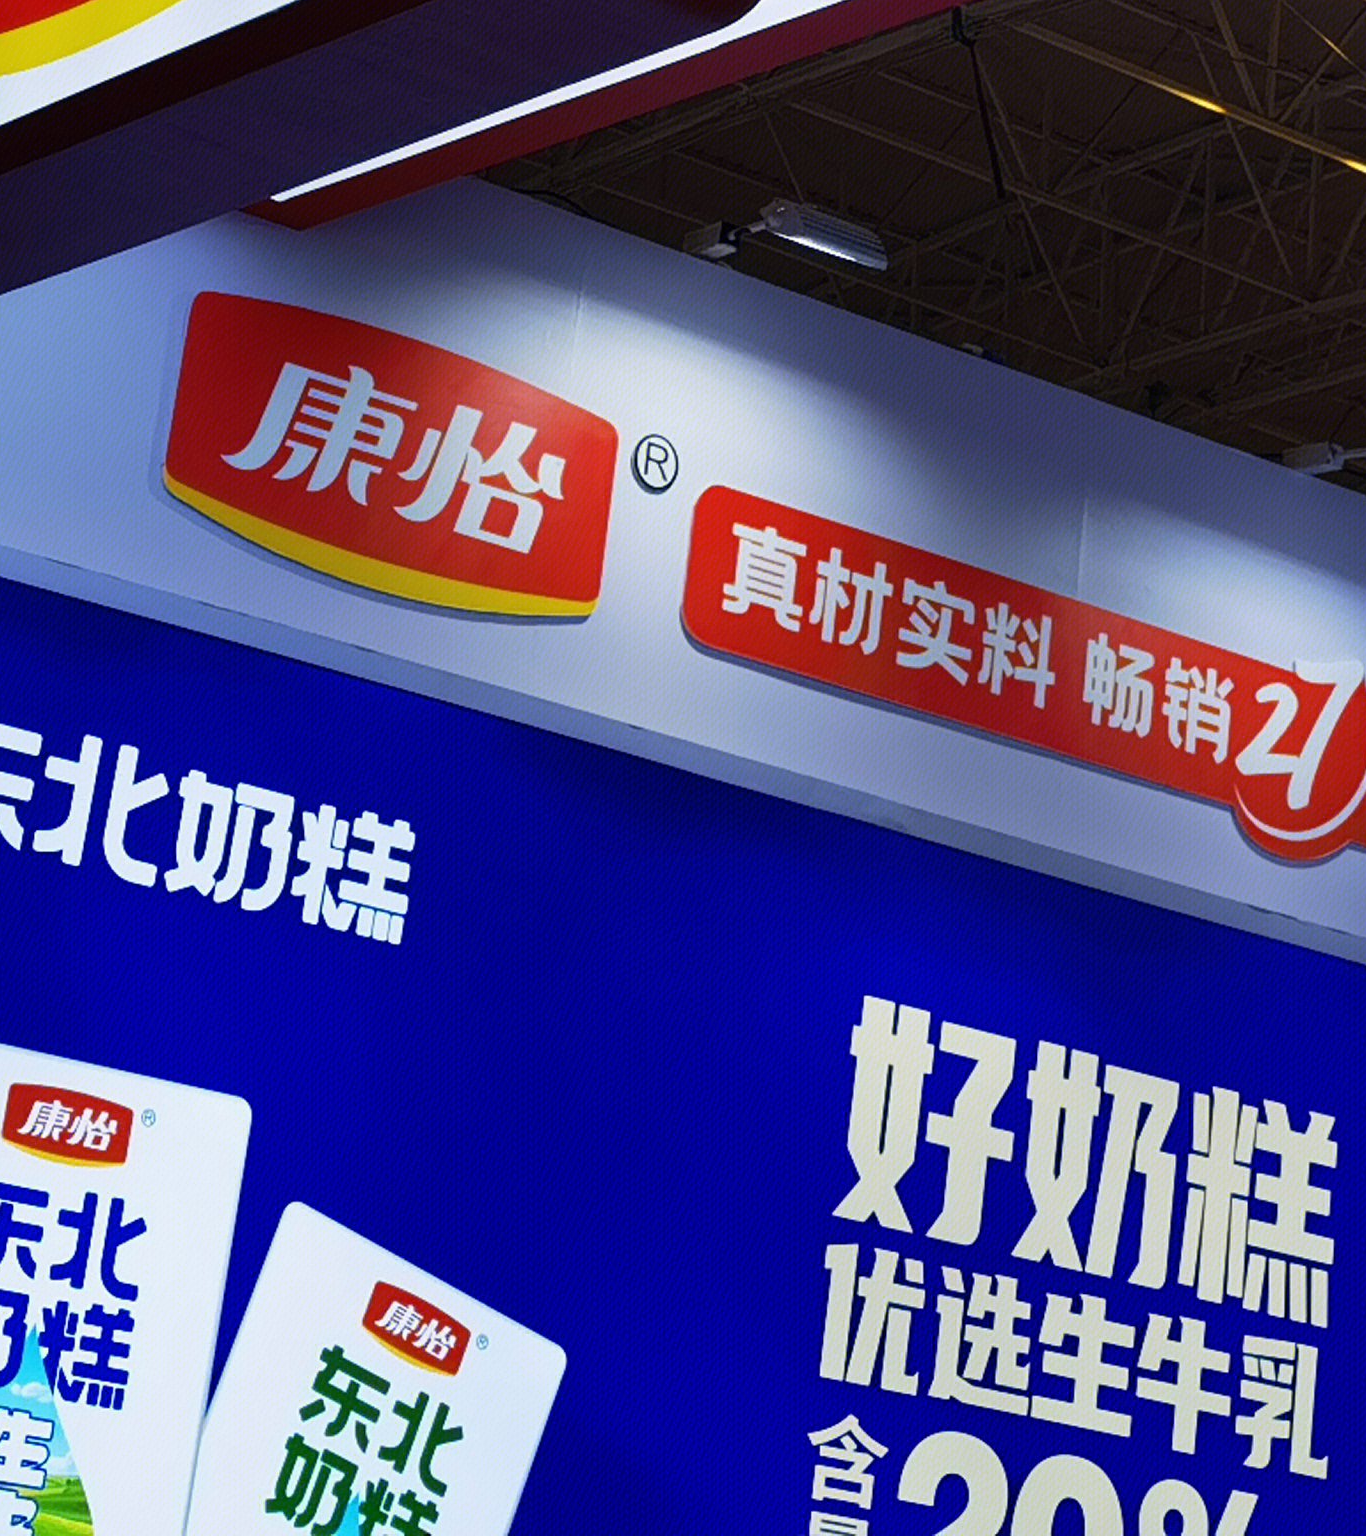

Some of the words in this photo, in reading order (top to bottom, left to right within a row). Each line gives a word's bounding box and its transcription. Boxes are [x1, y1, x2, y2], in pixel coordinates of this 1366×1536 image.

[220, 361, 566, 555] 康怡
[721, 521, 1056, 710] 真材实料
[17, 1099, 118, 1152] 康怡
[832, 995, 1338, 1329] 好奶糕
[299, 1344, 464, 1497] 东北
[374, 1300, 457, 1361] 康怡
[819, 1244, 1330, 1480] 优选生牛乳
